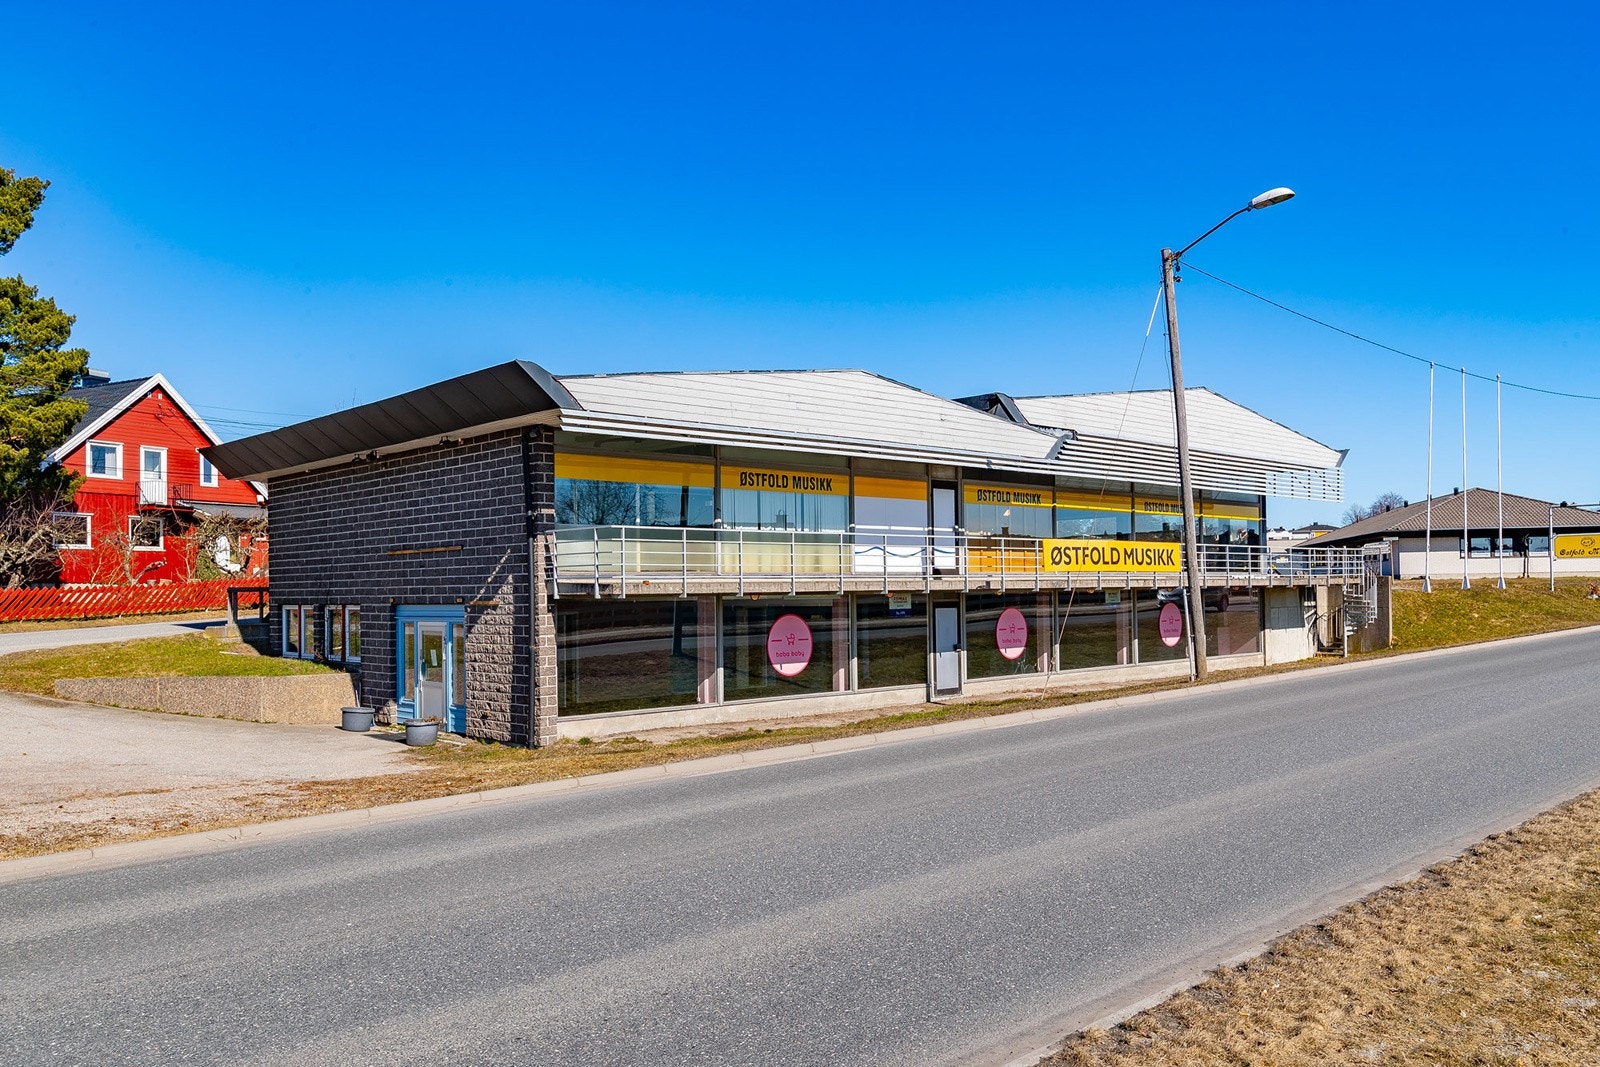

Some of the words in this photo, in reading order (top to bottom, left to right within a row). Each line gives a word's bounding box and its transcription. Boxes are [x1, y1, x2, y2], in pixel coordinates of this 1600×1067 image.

[740, 471, 789, 488] ØSTFOLD
[792, 475, 832, 491] MUSIKK
[977, 489, 1011, 503] ØSTFOLD
[1013, 492, 1041, 504] MUSIKK
[1051, 546, 1121, 566] ØSTFOLD
[1123, 548, 1175, 566] MUSIKK
